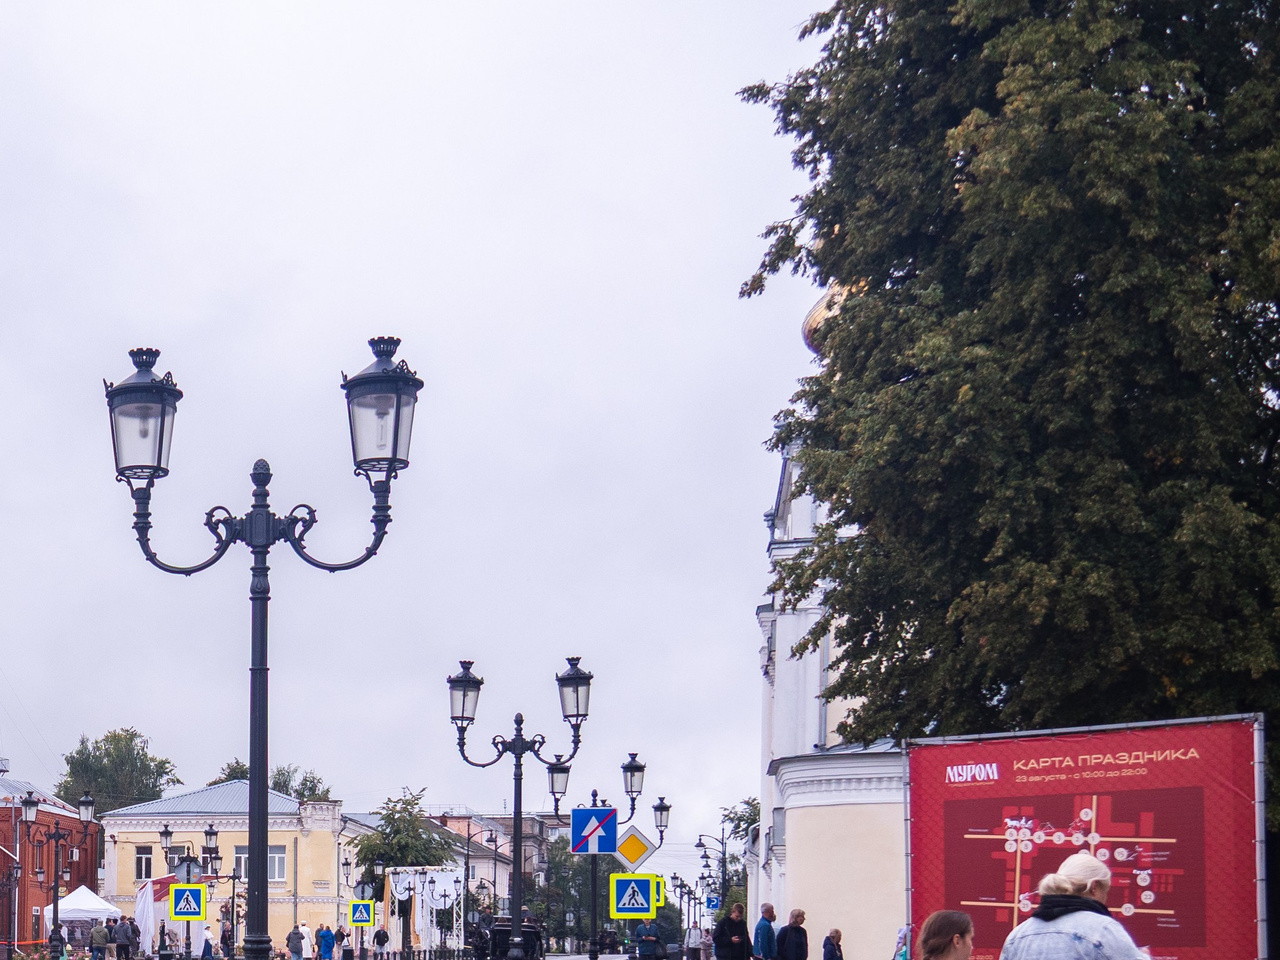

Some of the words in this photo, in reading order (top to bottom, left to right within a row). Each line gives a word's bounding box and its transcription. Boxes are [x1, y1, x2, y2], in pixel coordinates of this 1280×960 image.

[1013, 756, 1075, 771] КАРТА
[1078, 747, 1200, 767] ПРАЗДНИКА
[945, 763, 999, 783] МУРОМ
[1015, 775, 1027, 783] 23
[1028, 773, 1067, 783] августа
[1082, 769, 1105, 778] 10:00
[1106, 769, 1120, 778] до
[1120, 767, 1148, 776] 22:00
